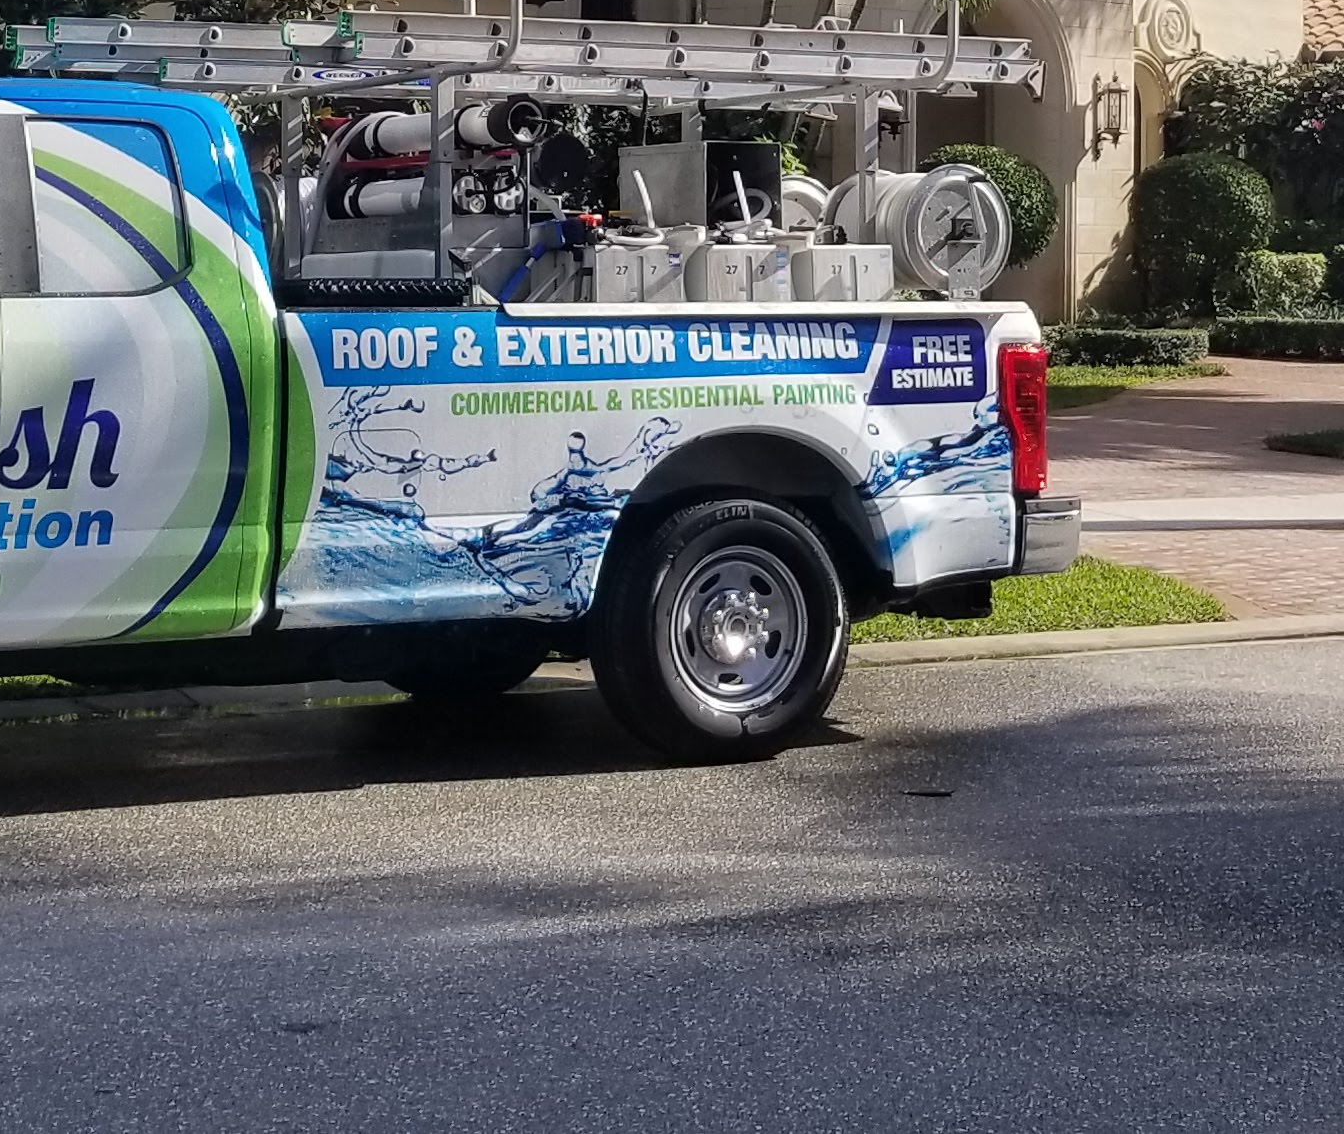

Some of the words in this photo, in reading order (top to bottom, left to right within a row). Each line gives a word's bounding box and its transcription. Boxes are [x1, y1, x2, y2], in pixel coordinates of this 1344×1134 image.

[615, 265, 629, 276] 27
[650, 265, 658, 276] 7
[725, 265, 738, 276] 27
[758, 265, 766, 276] 7
[331, 326, 439, 370] ROOF
[451, 325, 484, 367] &
[495, 322, 677, 367] EXTERIOR
[687, 320, 860, 362] CLEANING
[912, 334, 973, 364] FREE
[891, 366, 974, 389] ESTIMATE
[450, 389, 599, 416] COMMERCIAL
[606, 388, 623, 412] &
[631, 384, 765, 411] RESIDENTIAL
[772, 382, 856, 406] PAINTING
